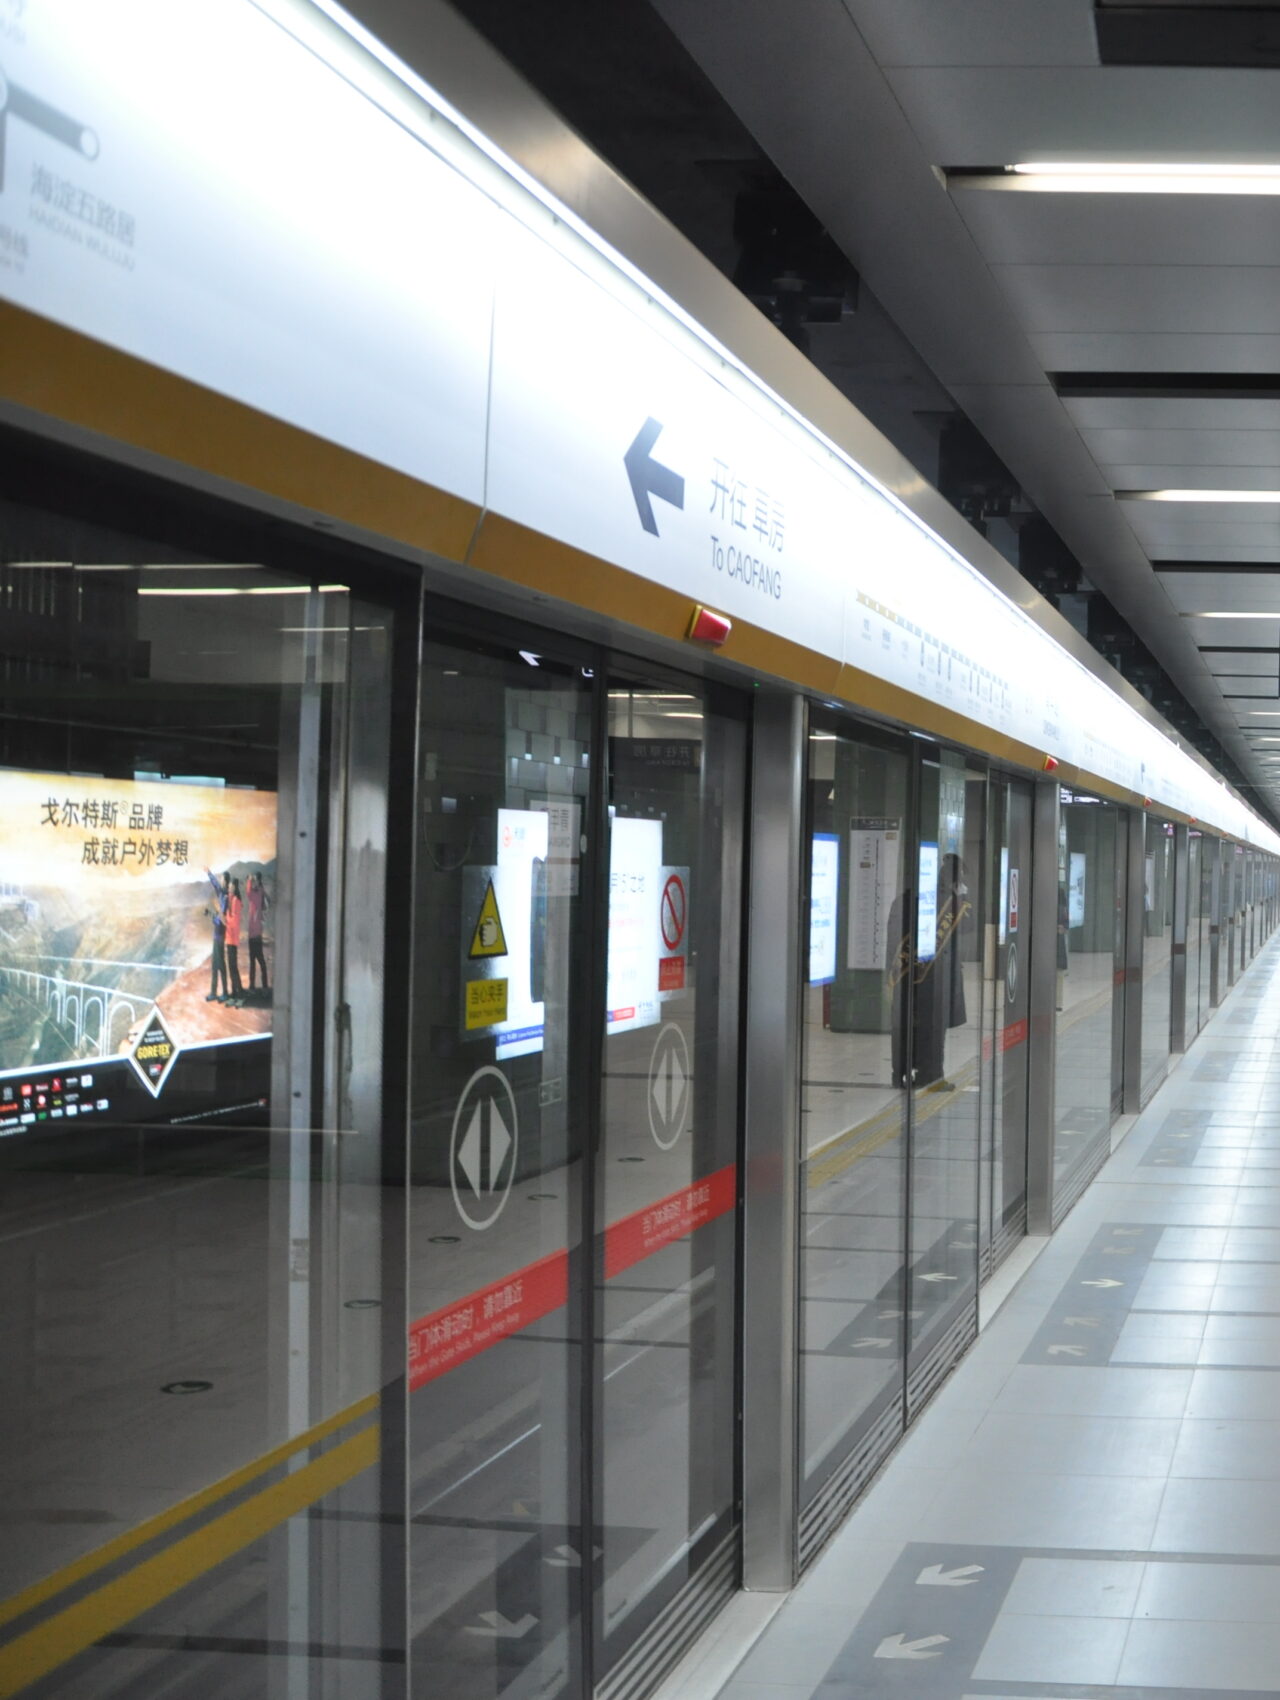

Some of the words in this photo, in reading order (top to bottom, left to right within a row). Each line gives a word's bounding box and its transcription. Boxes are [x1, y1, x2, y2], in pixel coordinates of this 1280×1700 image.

[711, 535, 724, 571] To
[727, 546, 781, 600] CAOFANG
[81, 837, 189, 866] 成就户外梦想
